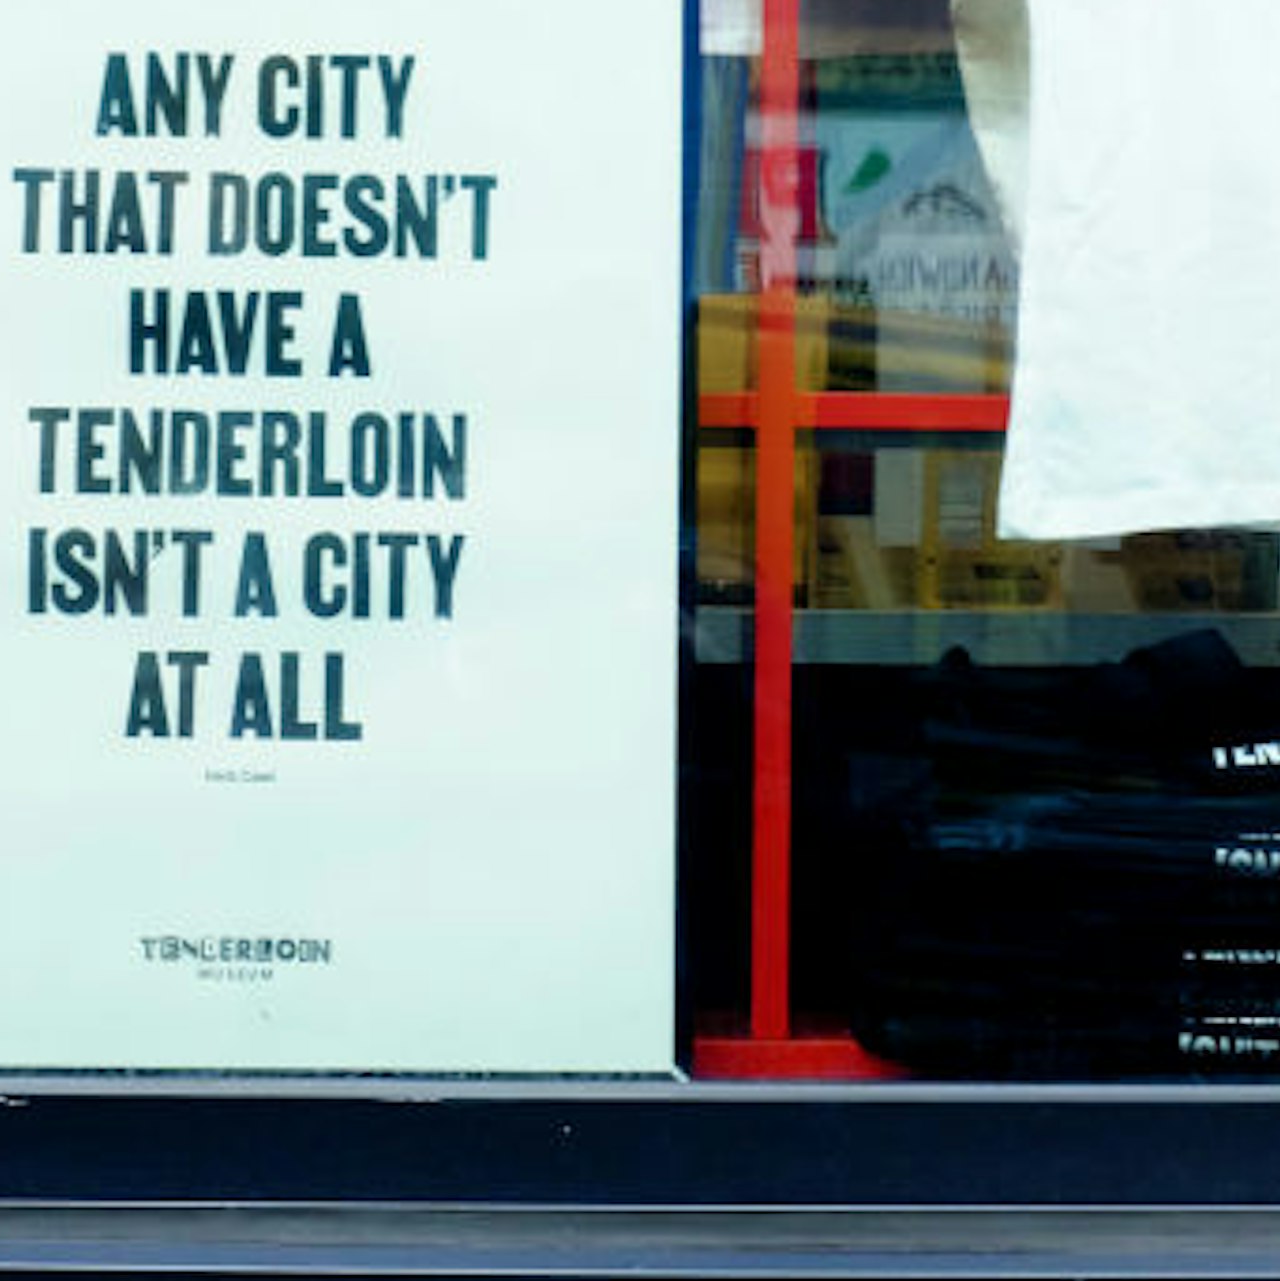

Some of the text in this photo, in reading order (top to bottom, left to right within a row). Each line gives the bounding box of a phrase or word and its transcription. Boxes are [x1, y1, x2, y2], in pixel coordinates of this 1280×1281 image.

[96, 51, 416, 140] ANY CITY
[13, 168, 498, 261] THAT DOESN'T
[129, 288, 373, 378] HAVE A
[28, 407, 468, 500] TENDERLOIN
[28, 528, 466, 620] ISN'T A CITY
[125, 650, 363, 741] AT ALL
